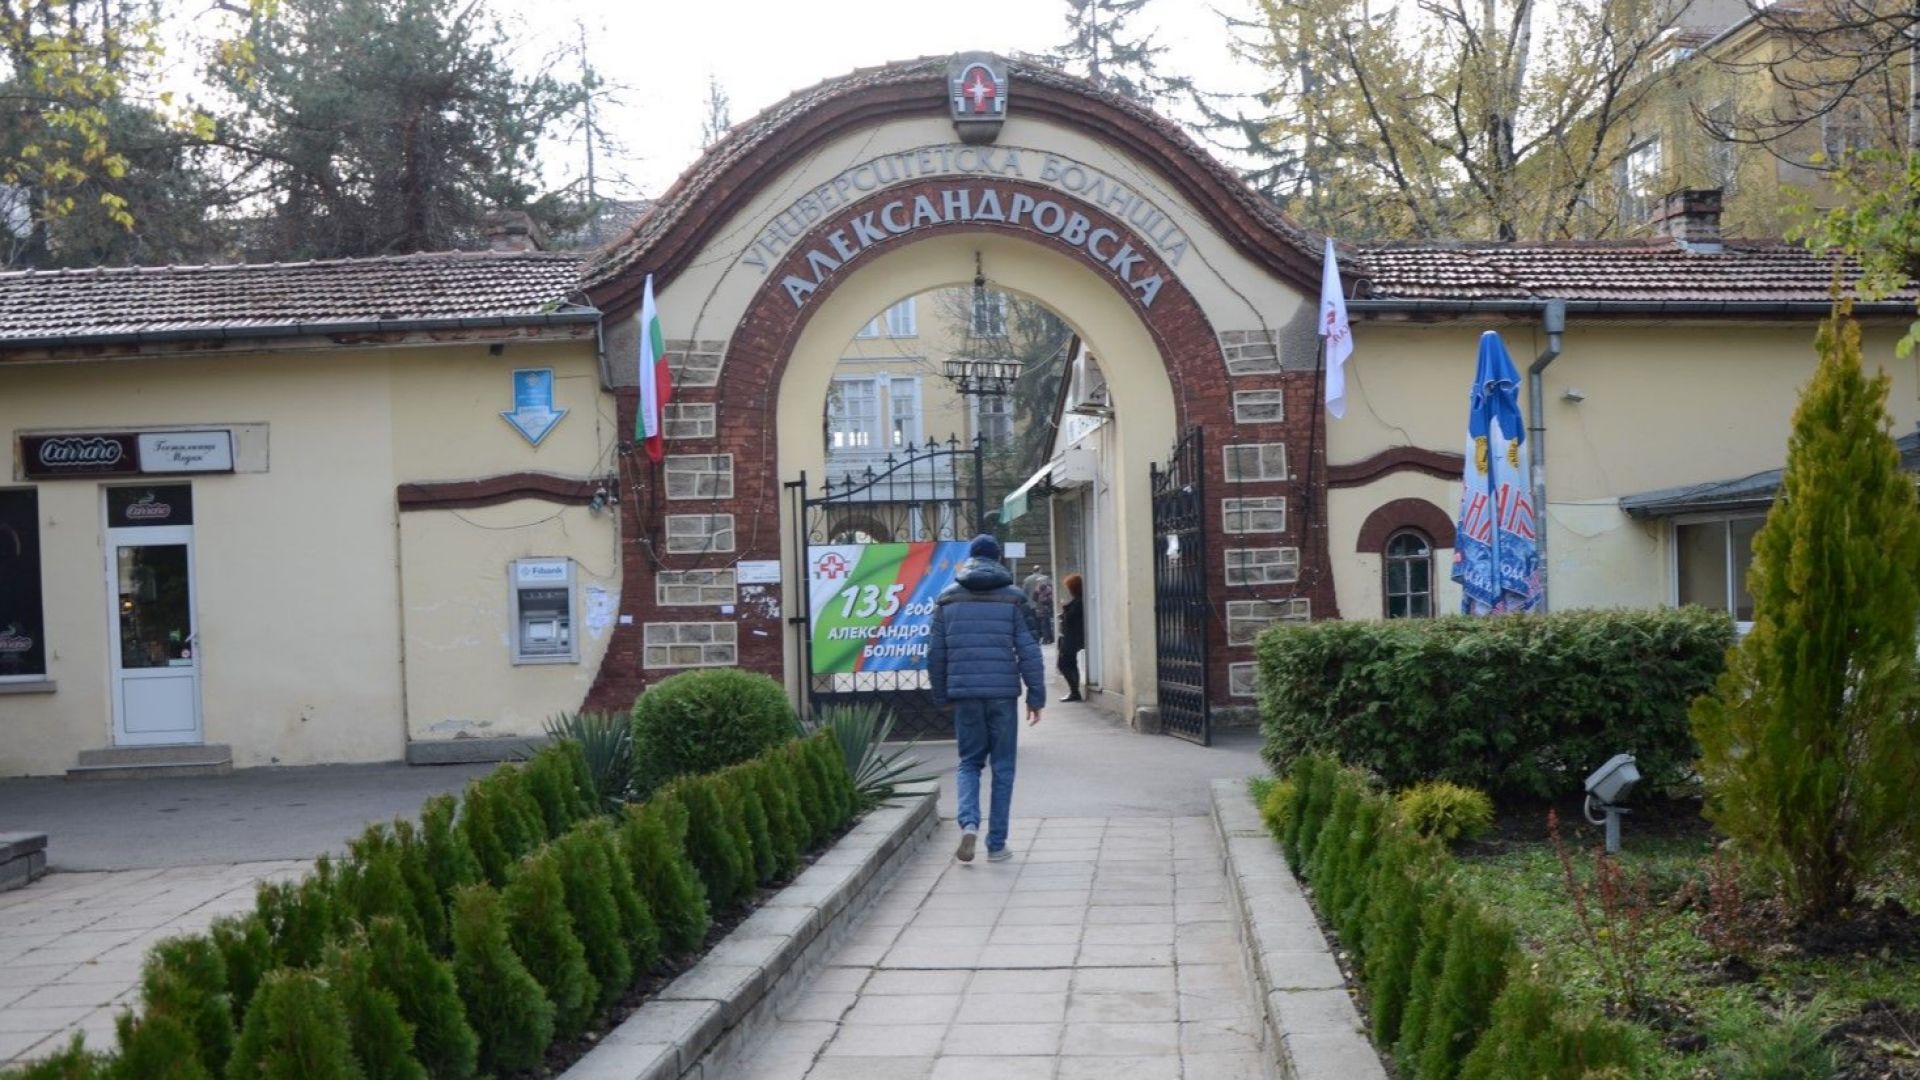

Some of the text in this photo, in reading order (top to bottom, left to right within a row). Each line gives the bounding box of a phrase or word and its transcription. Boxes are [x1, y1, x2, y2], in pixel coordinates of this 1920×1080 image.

[781, 189, 1166, 309] АЛЕКСАНДРОВСКА
[42, 439, 121, 463] Carraro
[841, 584, 934, 618] 135 год
[828, 624, 930, 640] АЛЕКСАНДРО
[863, 643, 928, 658] БОЛНИЦ
